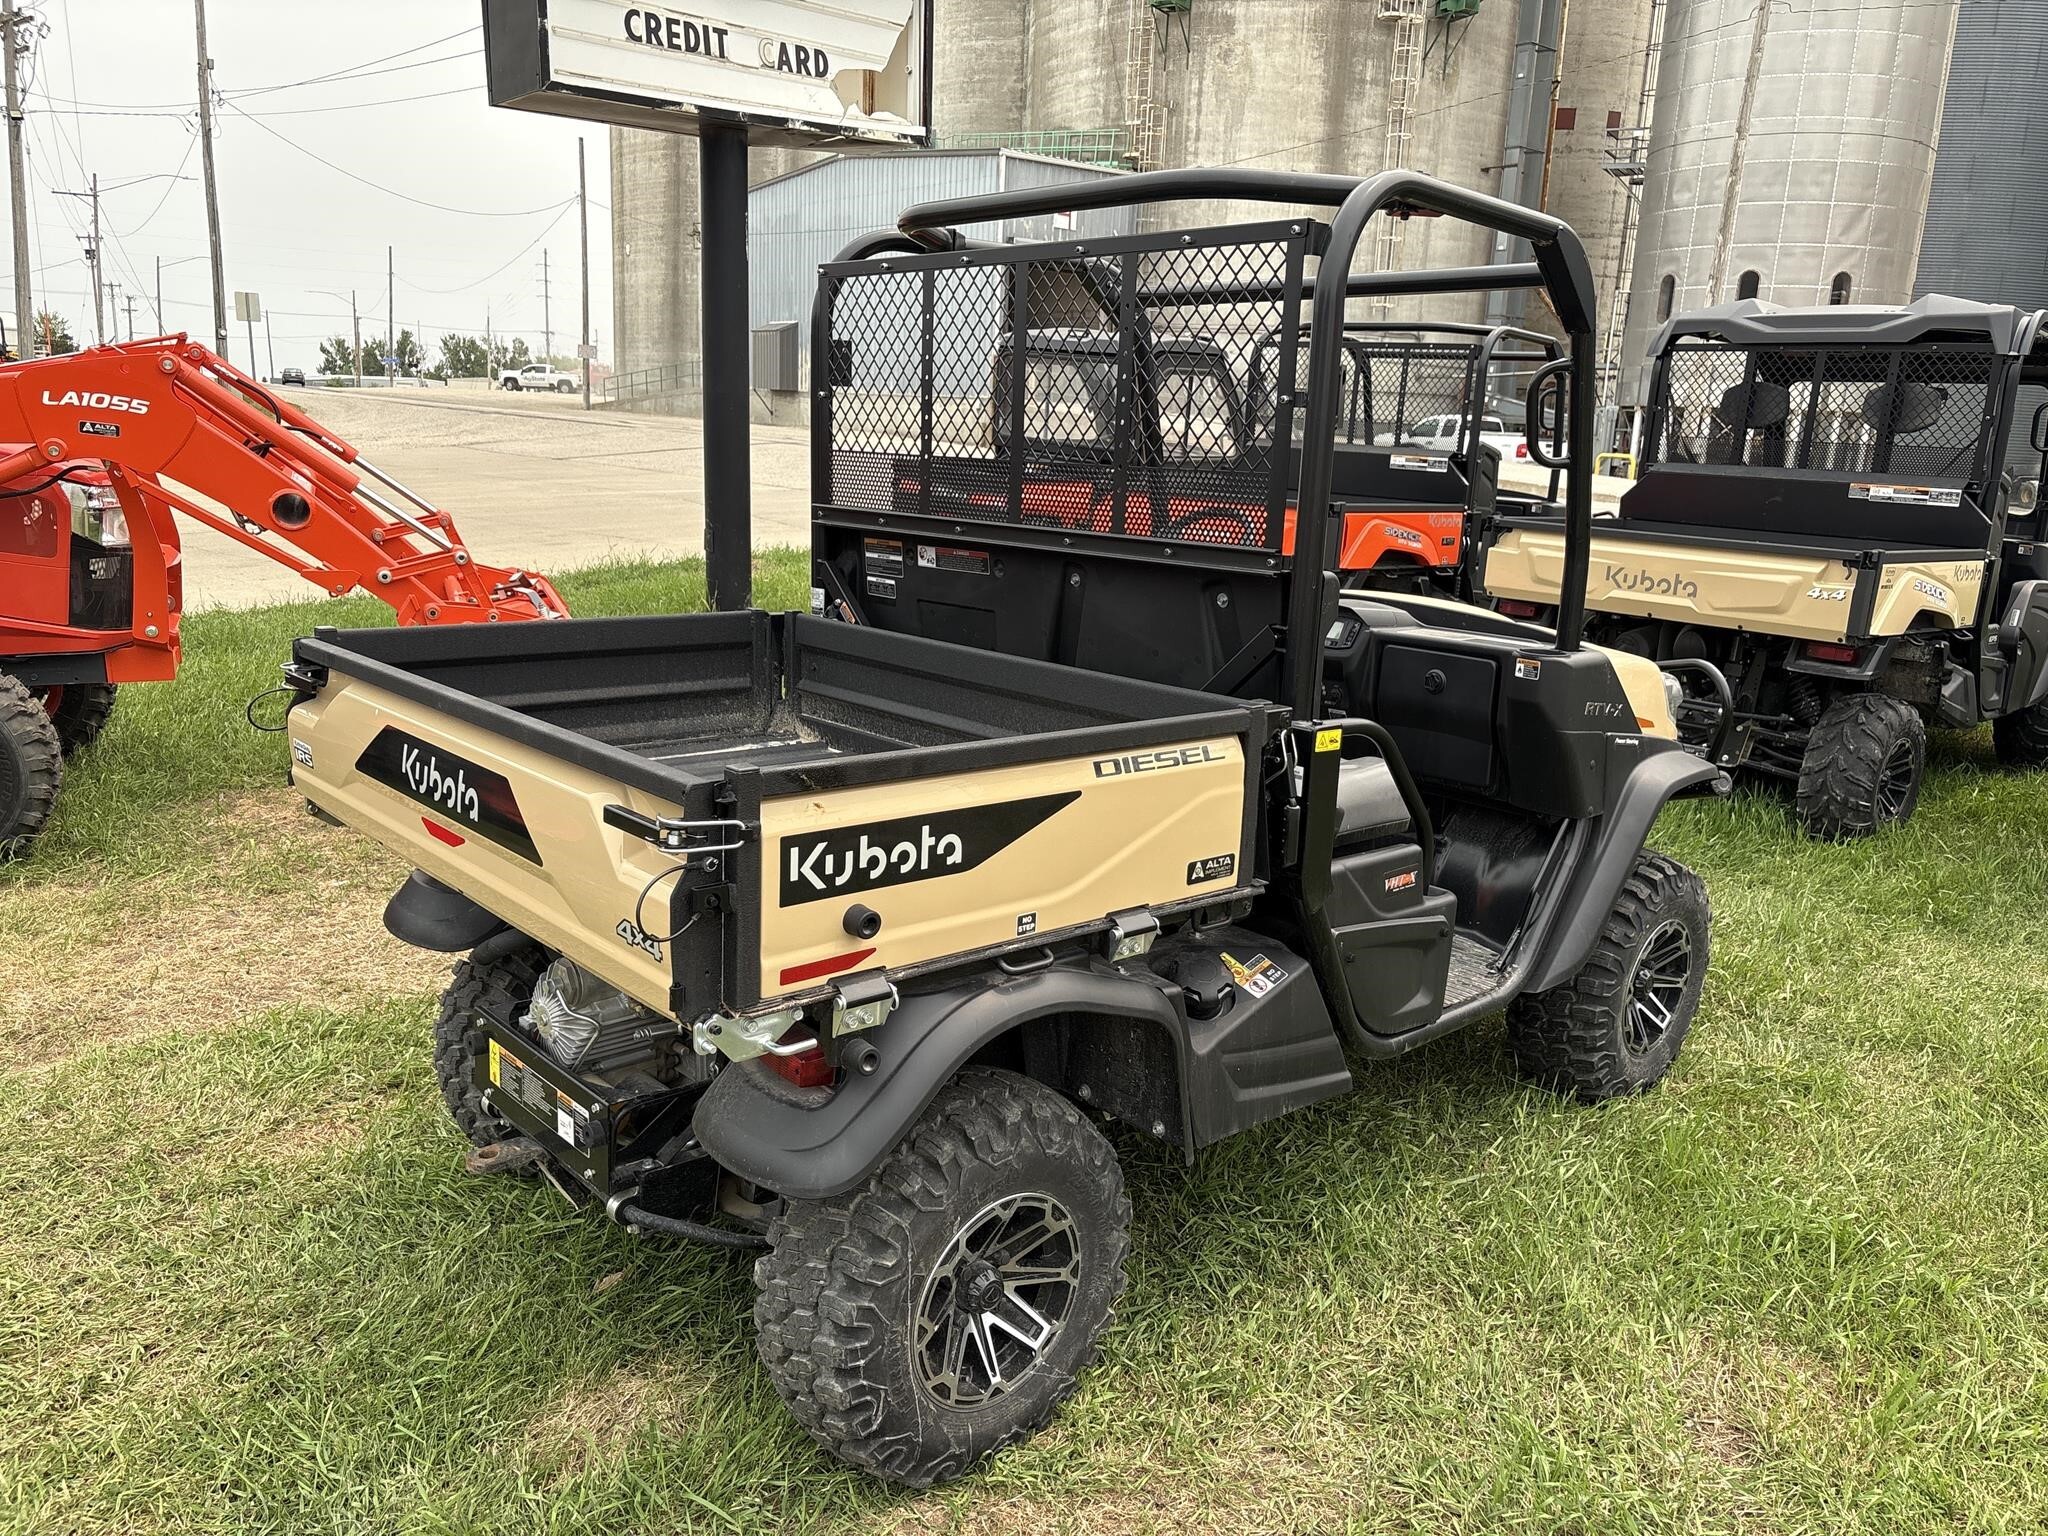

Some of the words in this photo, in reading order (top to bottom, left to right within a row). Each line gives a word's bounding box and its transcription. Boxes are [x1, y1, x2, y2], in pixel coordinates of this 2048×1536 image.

[624, 8, 729, 60] CREDIT
[758, 38, 830, 79] CARD
[42, 390, 150, 415] LA1055
[94, 423, 116, 431] ALTA
[1605, 565, 1698, 598] Kubota
[1954, 565, 1982, 582] Kubota
[1807, 587, 1847, 601] 4x4
[1584, 702, 1624, 717] RTV-X
[1093, 745, 1226, 778] DIESEL
[402, 743, 479, 822] Kubota
[789, 825, 963, 890] Kubota
[1205, 856, 1231, 869] ALTA
[1022, 915, 1032, 923] NO
[1018, 923, 1035, 933] STEP
[616, 918, 663, 963] 4x4
[1266, 968, 1275, 976] NO
[1269, 970, 1282, 982] STEP
